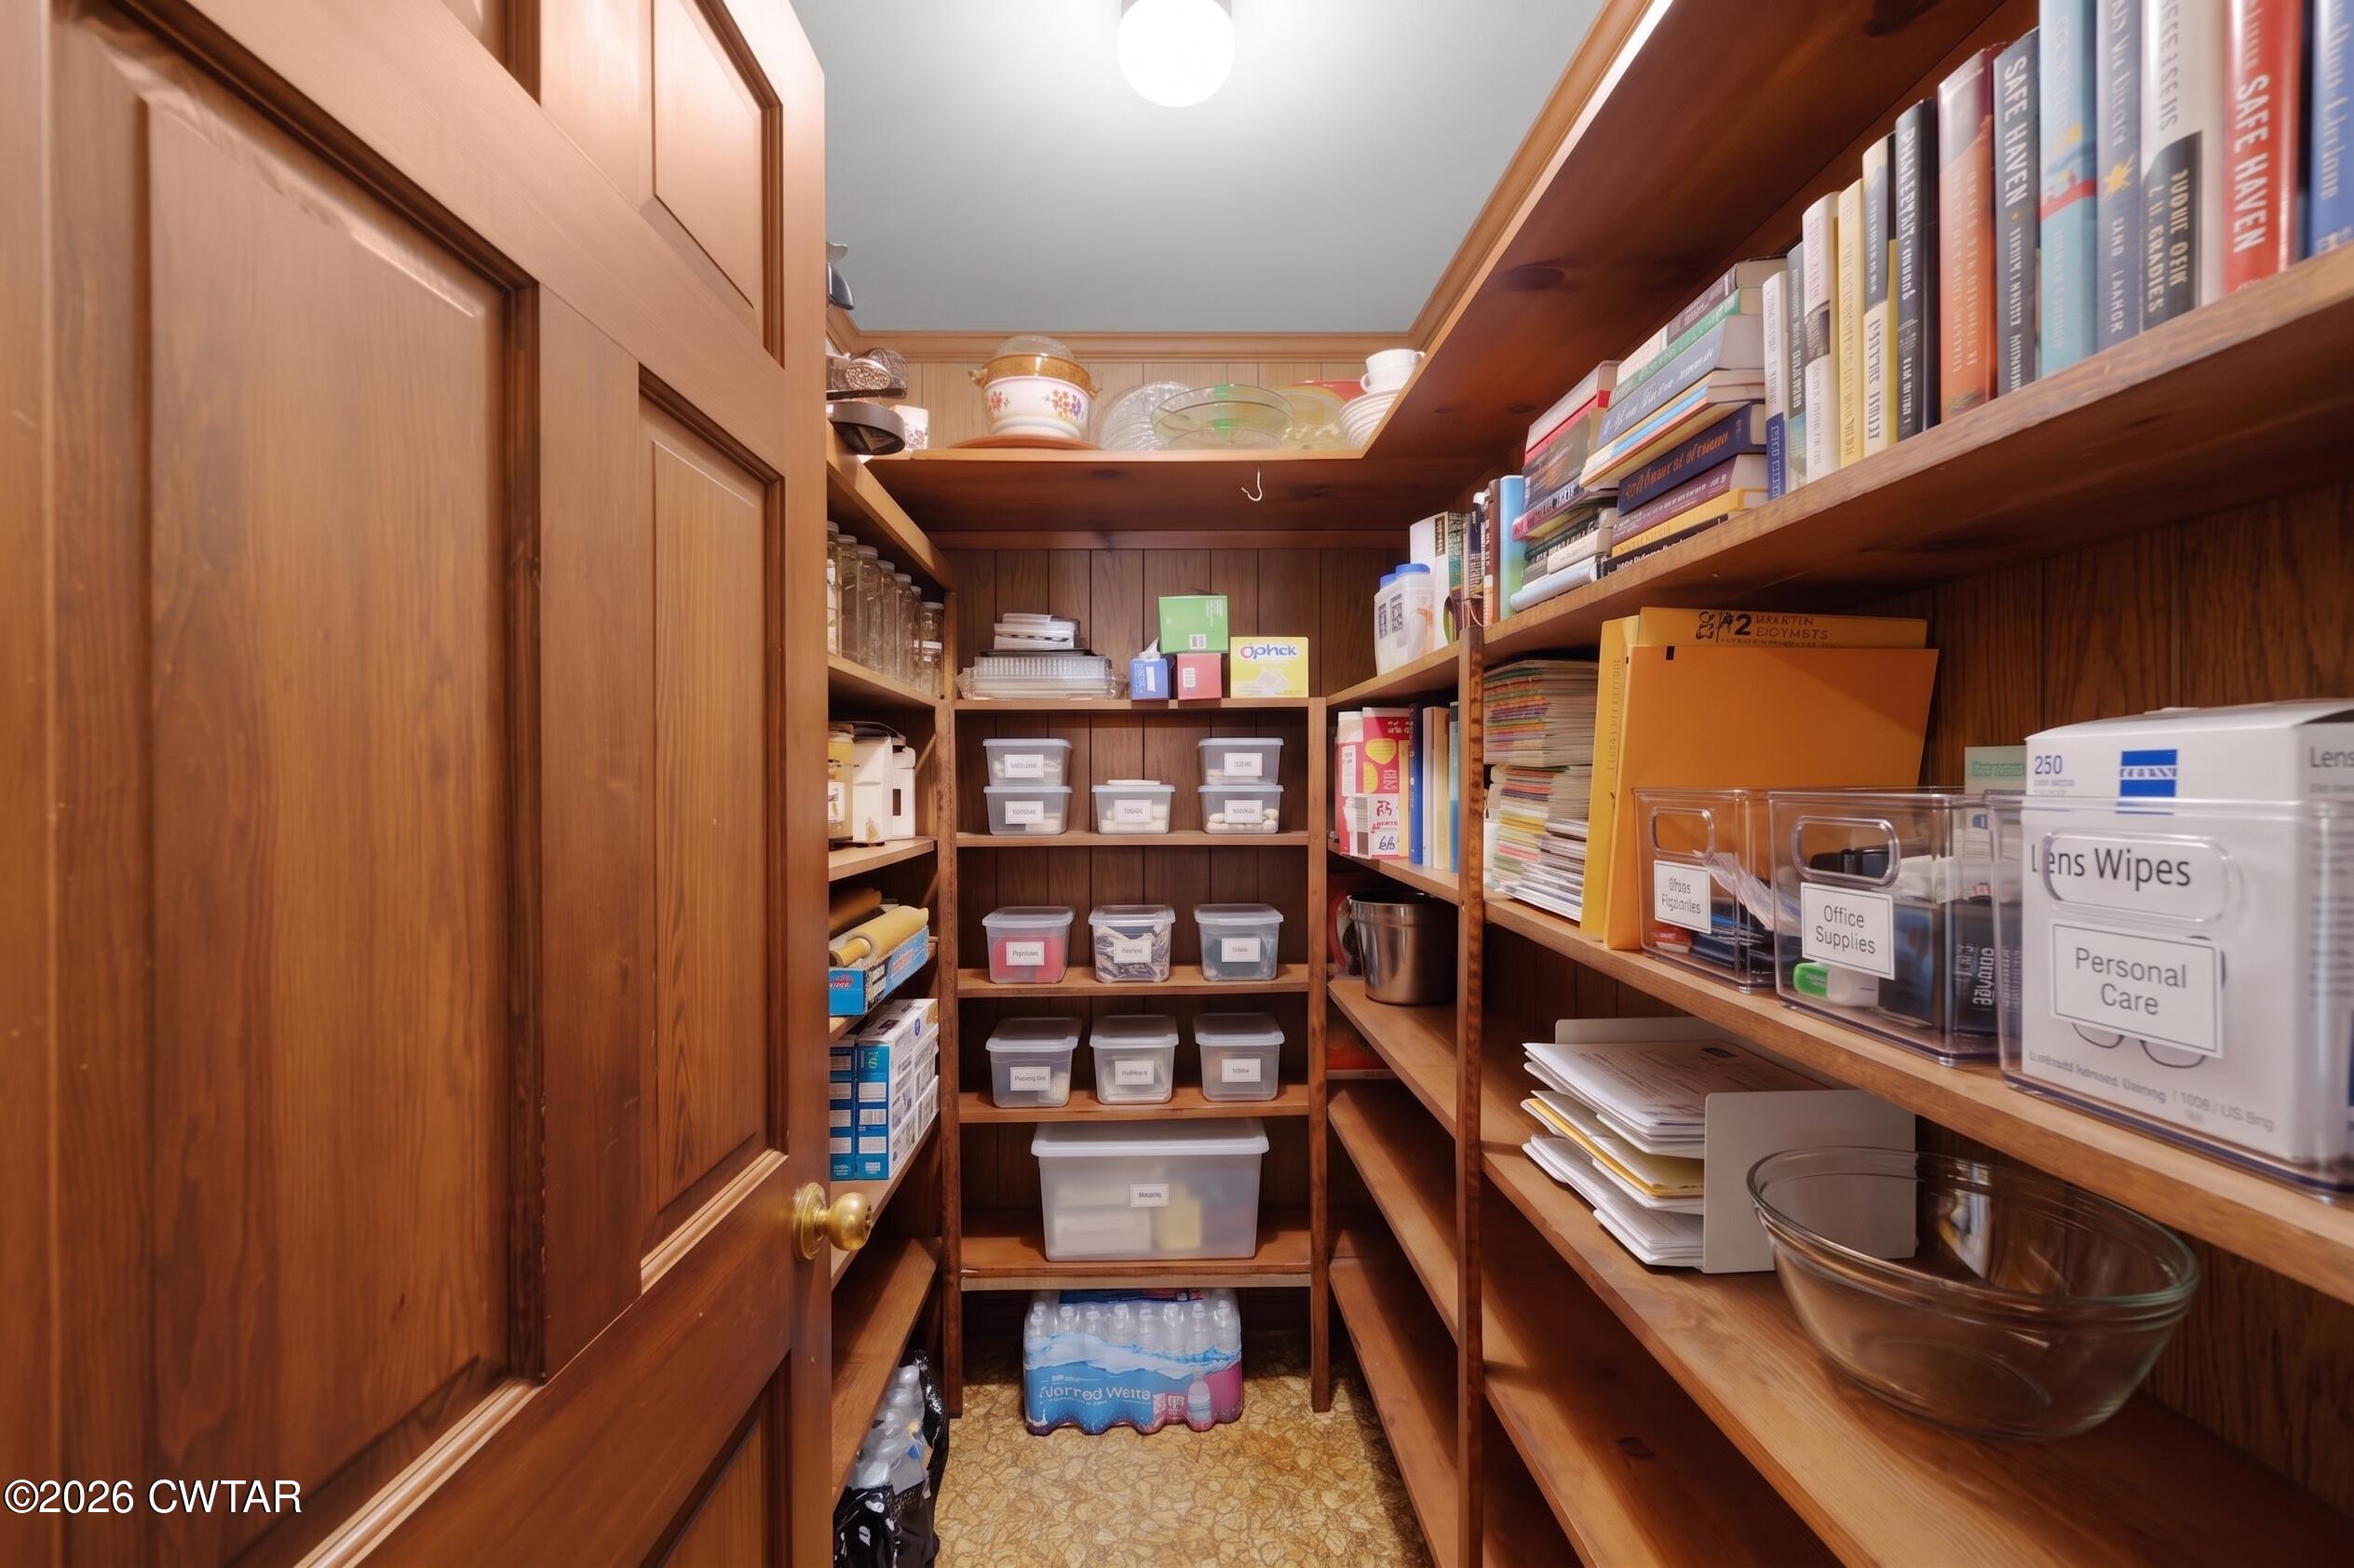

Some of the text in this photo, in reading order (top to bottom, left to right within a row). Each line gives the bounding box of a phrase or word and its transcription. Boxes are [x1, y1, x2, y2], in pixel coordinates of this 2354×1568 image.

[2005, 55, 2028, 122] SAFE
[2235, 74, 2270, 152] SAFE
[2004, 122, 2028, 208] HAVEN
[2233, 153, 2269, 253] HAVEN
[2034, 754, 2063, 776] 250
[2032, 845, 2191, 891] Lens Wipes
[1823, 904, 1865, 928] Office
[1816, 926, 1876, 954] Supplies
[2075, 947, 2186, 989] Personal
[2101, 983, 2159, 1016] Care
